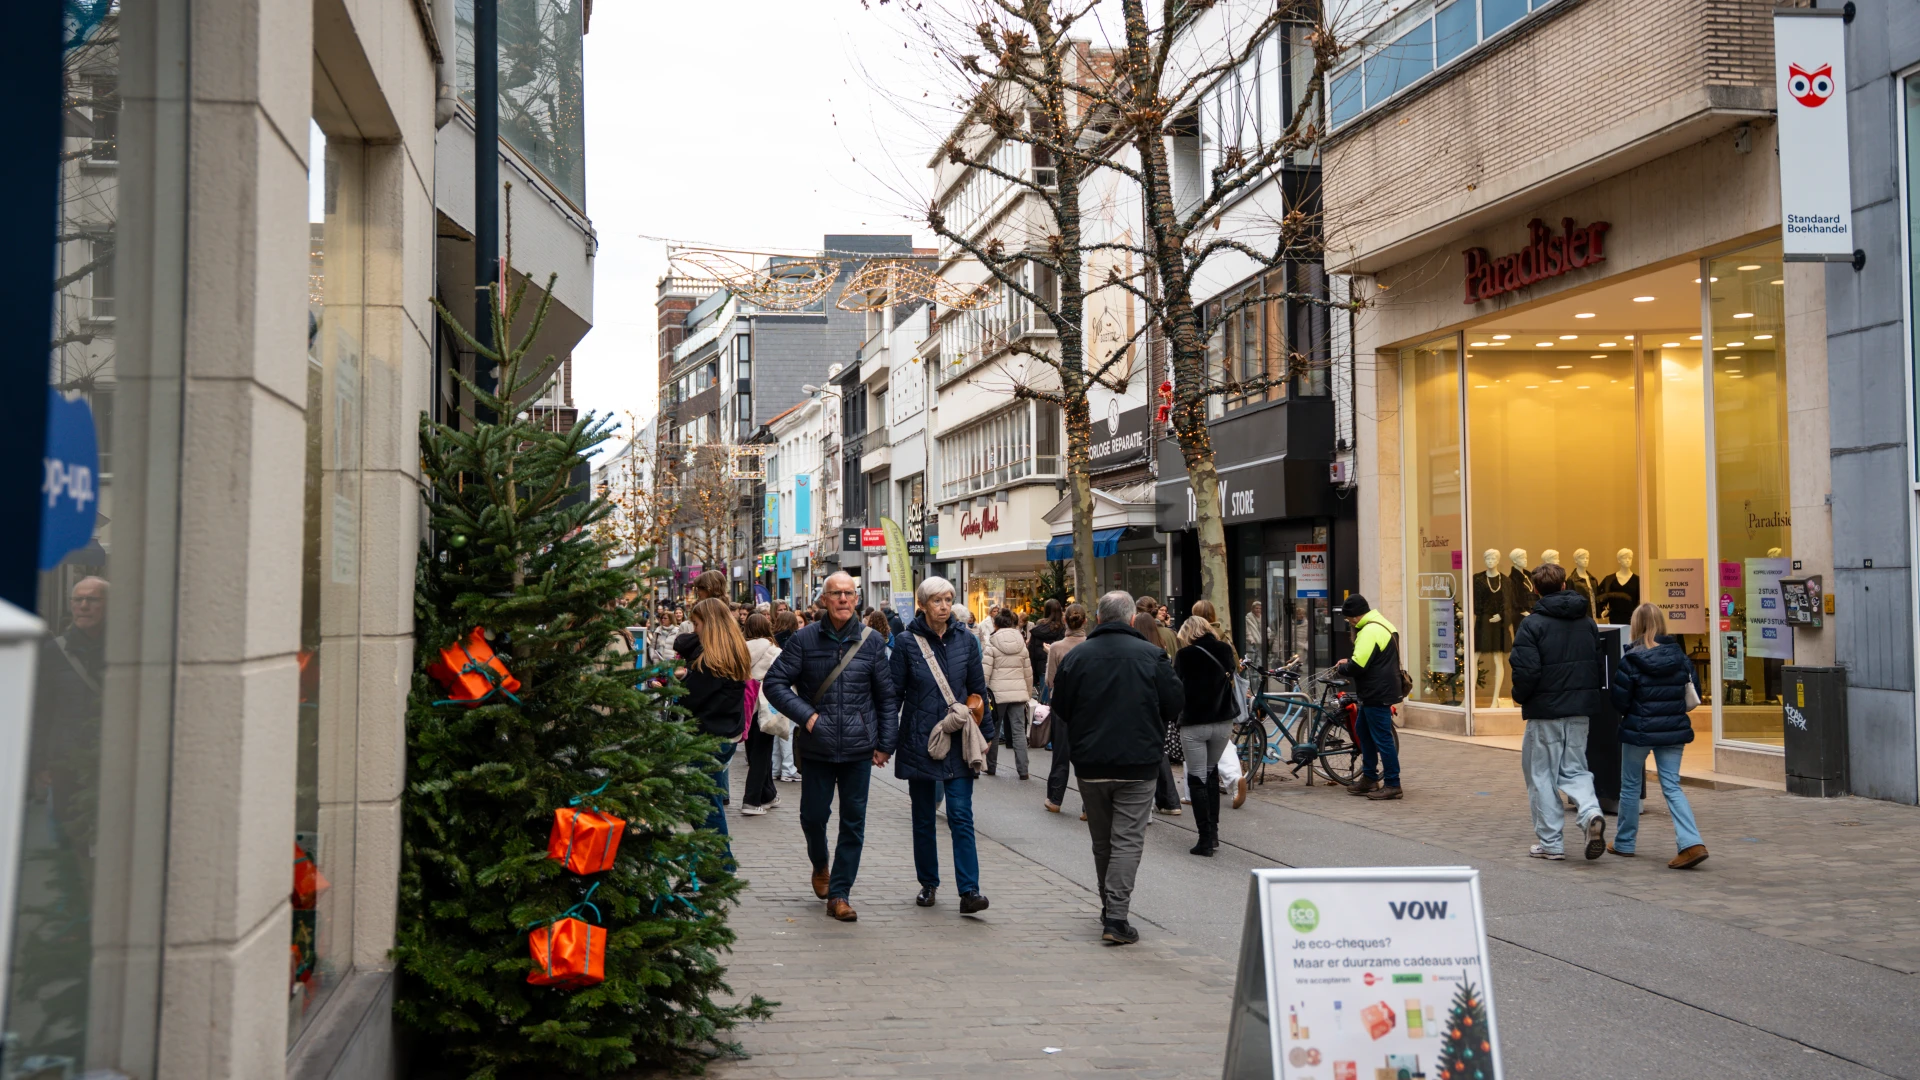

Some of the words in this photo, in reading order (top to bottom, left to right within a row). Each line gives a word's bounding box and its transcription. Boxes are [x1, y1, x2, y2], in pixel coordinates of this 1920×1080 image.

[1787, 214, 1840, 224] Standaard
[1787, 224, 1848, 234] Boekhandel
[1462, 217, 1610, 304] Paradisier
[1111, 431, 1143, 454] REPARATIE
[1232, 489, 1254, 516] STORE
[1301, 554, 1324, 564] MCA
[1762, 599, 1775, 608] -20%
[1763, 629, 1776, 638] -30%
[1291, 908, 1315, 920] ECO
[1292, 939, 1306, 950] Je
[1308, 937, 1392, 951] eco-cheques?
[1327, 959, 1340, 968] er
[1342, 957, 1401, 968] duurzame
[1403, 955, 1453, 967] cadeaus
